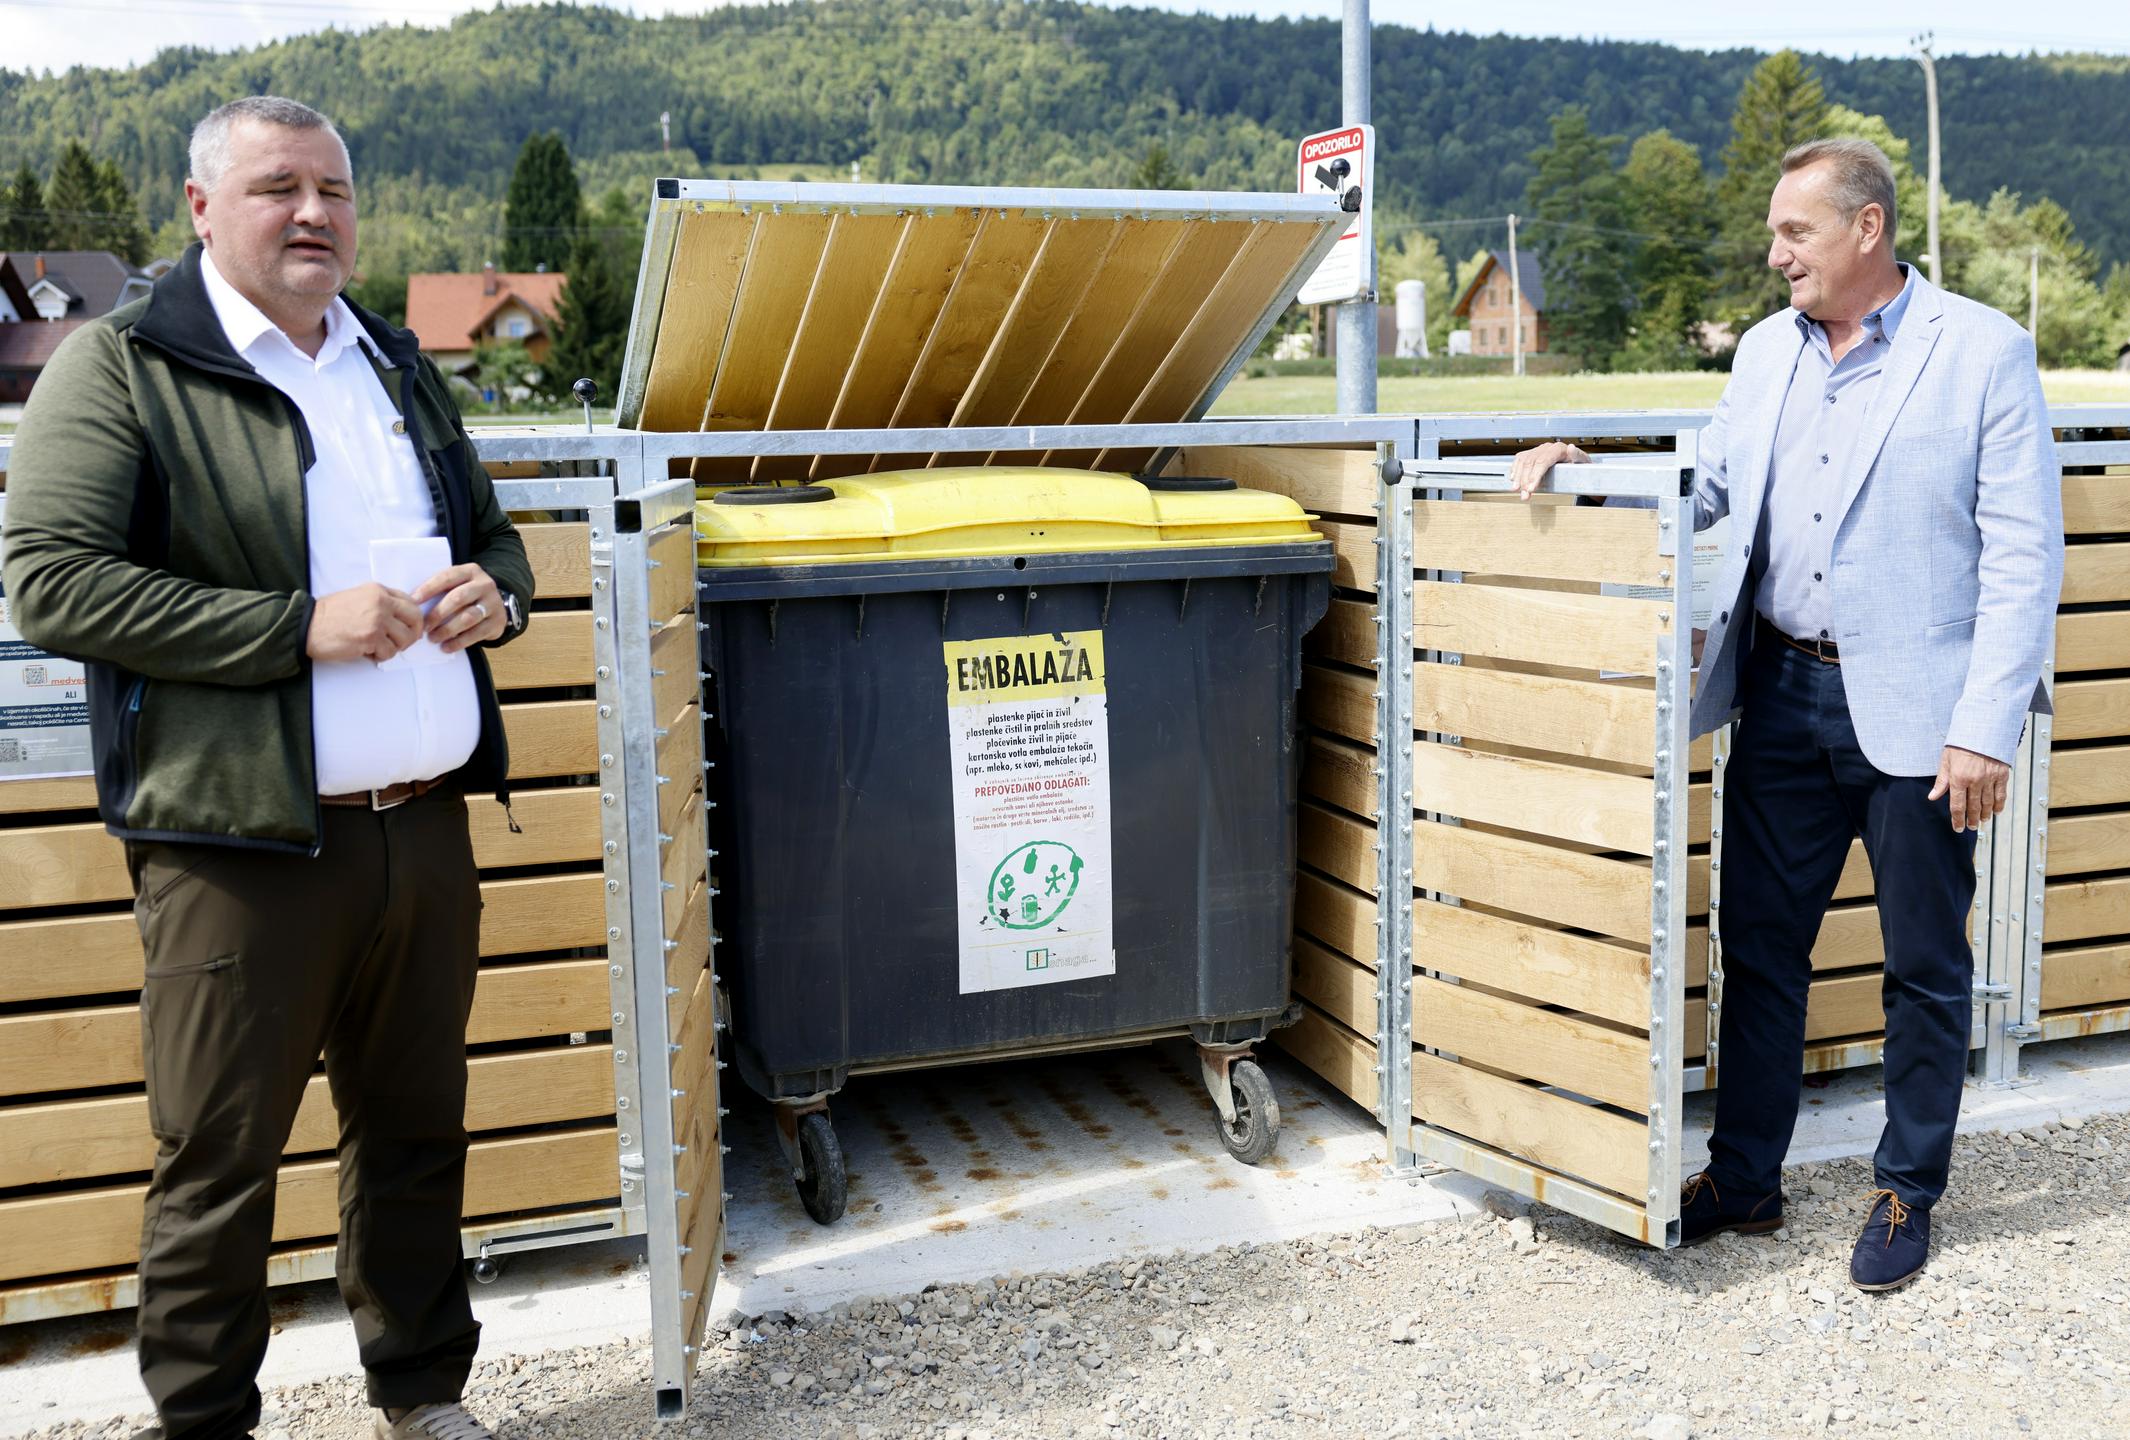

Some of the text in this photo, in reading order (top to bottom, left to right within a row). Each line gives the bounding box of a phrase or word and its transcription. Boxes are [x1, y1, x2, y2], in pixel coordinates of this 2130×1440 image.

[1305, 133, 1361, 159] OPOZORILO
[957, 643, 1092, 691] EMBALAŽA
[65, 691, 76, 699] ALI
[988, 706, 1071, 726] plastenke pijač in živil
[966, 718, 1093, 740] plastenke čistil in pralnih sredstev
[986, 731, 1077, 750] pločevinke živil in pijače
[968, 741, 1093, 762] kartonska votla embalaža tekočin
[965, 764, 984, 776] (npr.
[986, 761, 1012, 772] mleko,
[1043, 755, 1078, 767] mehčalec
[1079, 752, 1097, 765] ipd.)
[975, 776, 1090, 797] PREPOVEDANO ODLAGATI:
